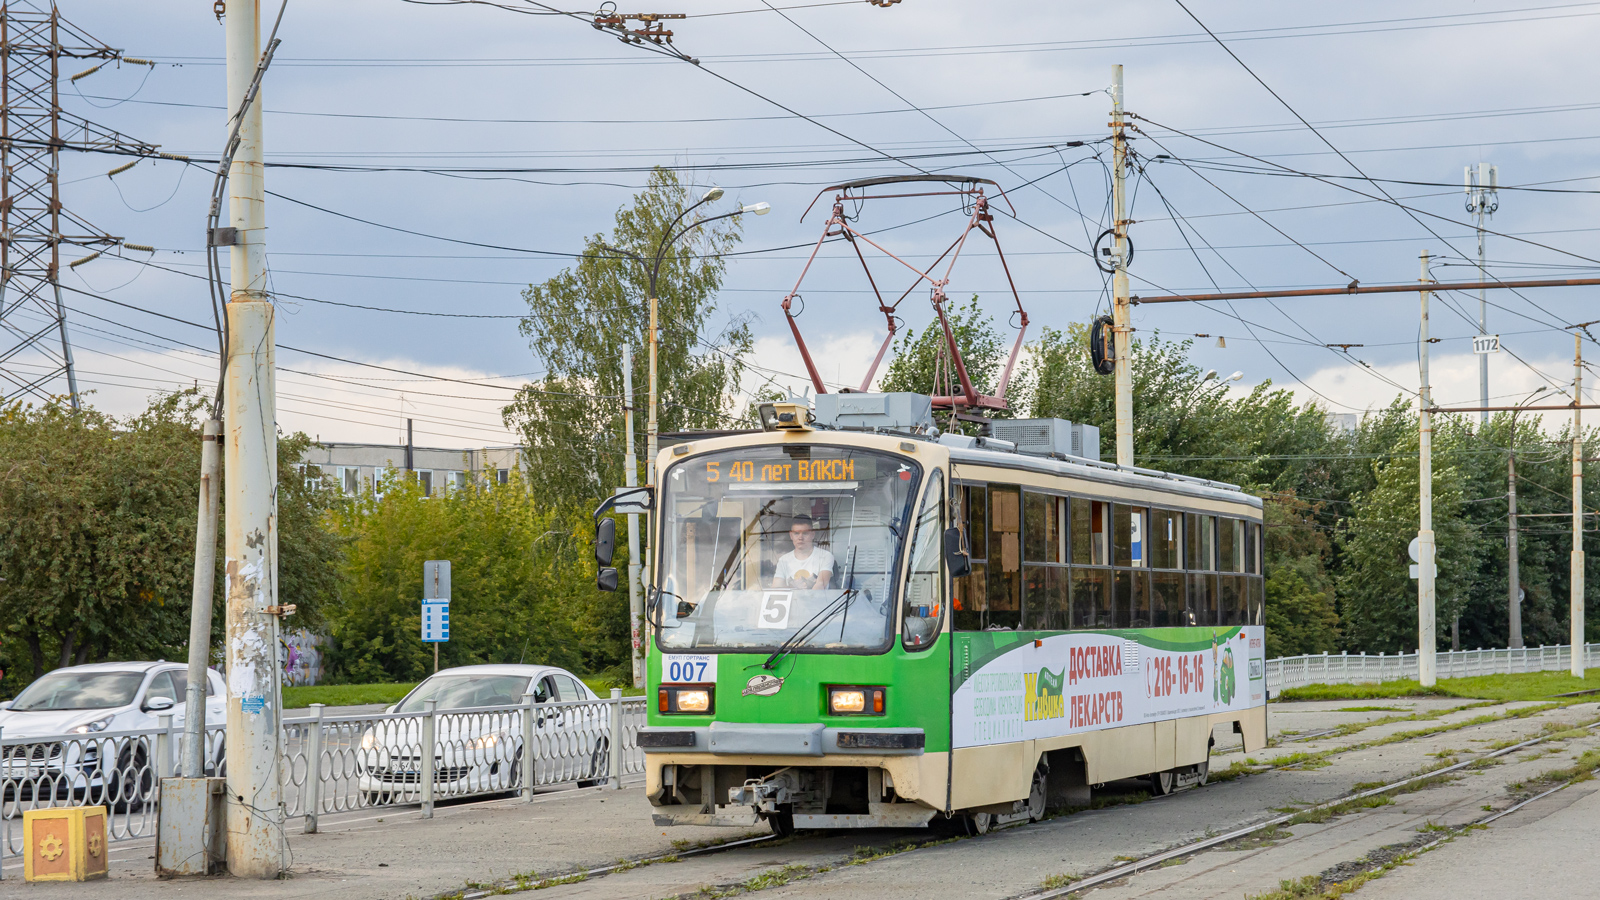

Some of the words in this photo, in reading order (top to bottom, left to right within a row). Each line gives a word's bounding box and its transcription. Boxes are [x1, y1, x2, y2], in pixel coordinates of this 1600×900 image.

[1474, 339, 1498, 351] 1172
[706, 462, 720, 482] 5
[729, 461, 754, 482] 40
[760, 464, 792, 481] лет
[798, 459, 855, 480] ВЛКСМ
[763, 595, 788, 623] 5
[669, 662, 708, 681] 007
[1069, 645, 1122, 685] ДОСТАВКА
[1044, 671, 1058, 688] АПТЕКИ
[1070, 691, 1123, 729] ЛЕКАРСТВ
